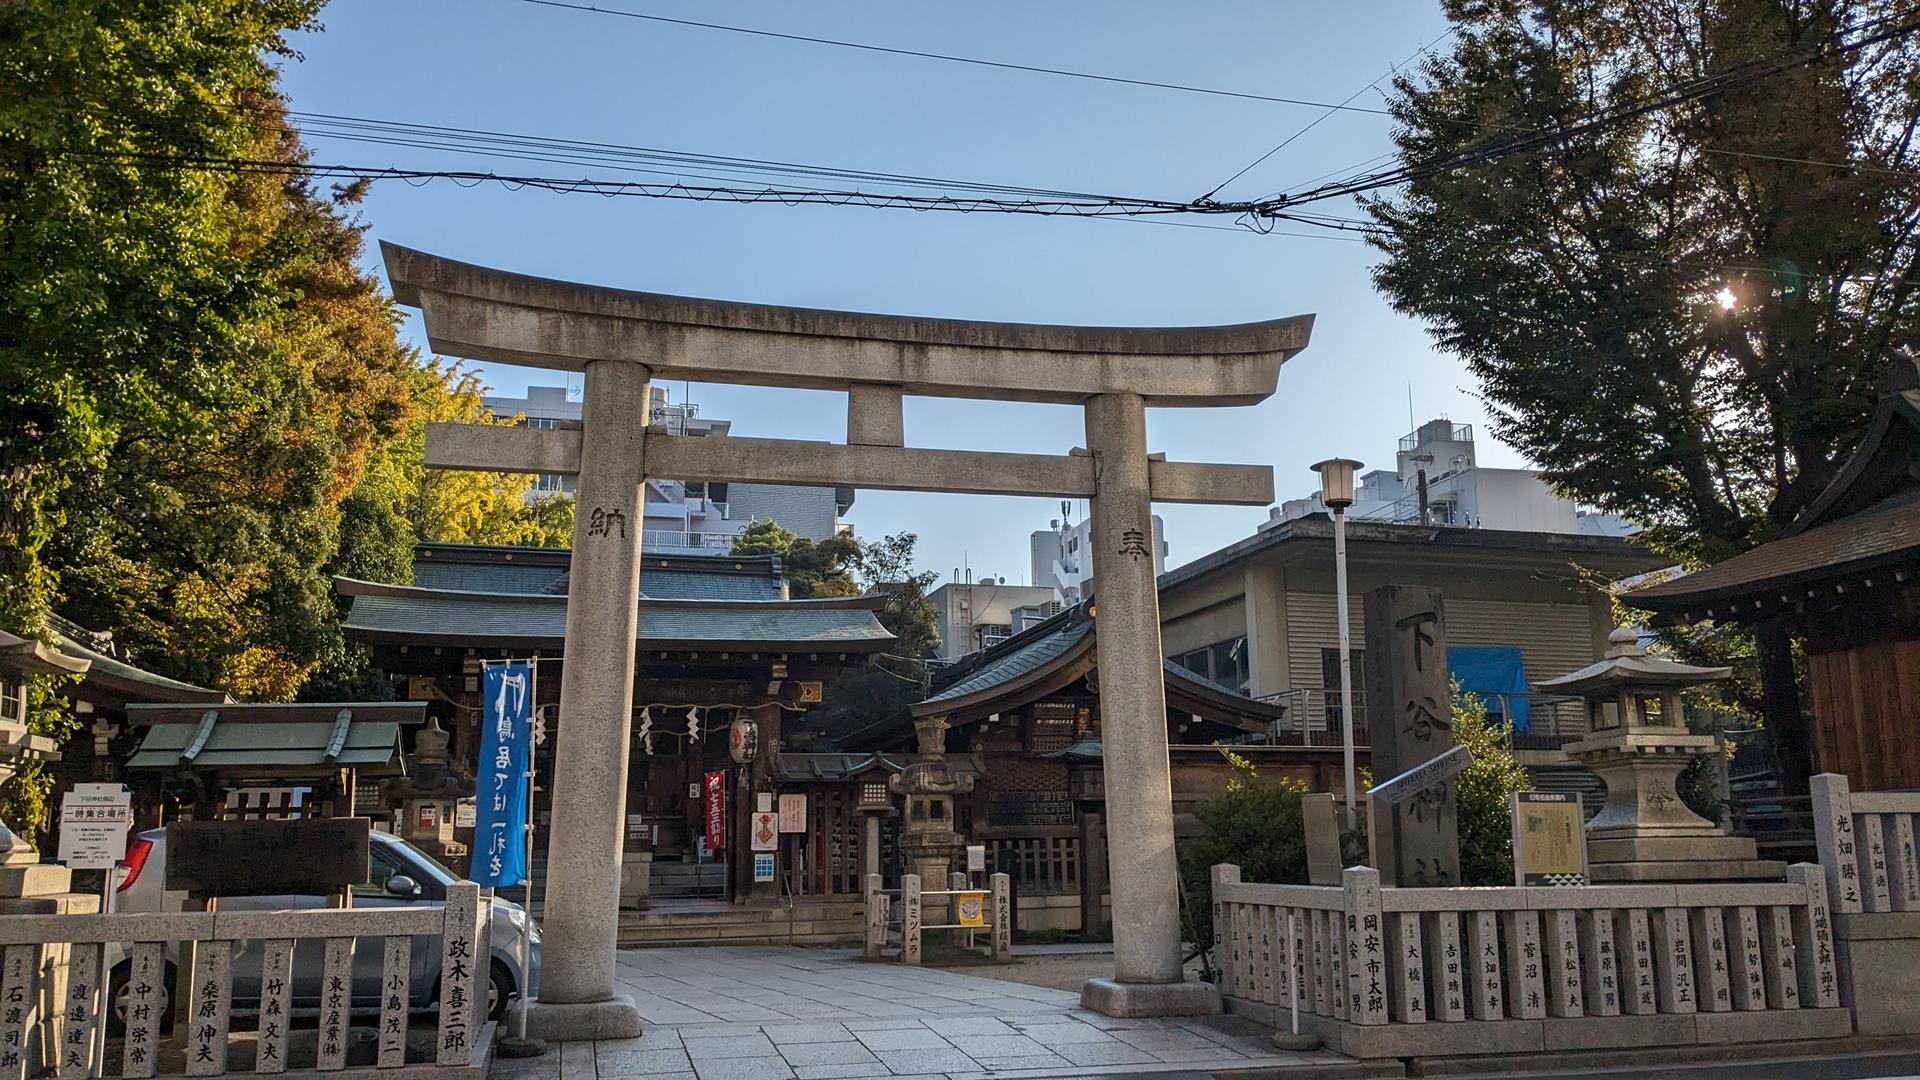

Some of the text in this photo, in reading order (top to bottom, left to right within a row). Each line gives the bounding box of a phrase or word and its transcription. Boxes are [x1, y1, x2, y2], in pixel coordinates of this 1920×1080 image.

[588, 507, 625, 539] 納
[1118, 528, 1150, 561] 奉
[64, 809, 127, 818] 一時集合場所
[444, 937, 471, 1052] 政木喜三郎
[1363, 914, 1383, 1013] 岡安市太郎
[129, 982, 152, 1065] 中村栄常
[196, 981, 220, 1063] 桑原伸夫
[262, 978, 284, 1061] 竹森文夫
[384, 974, 404, 1053] 小島茂二
